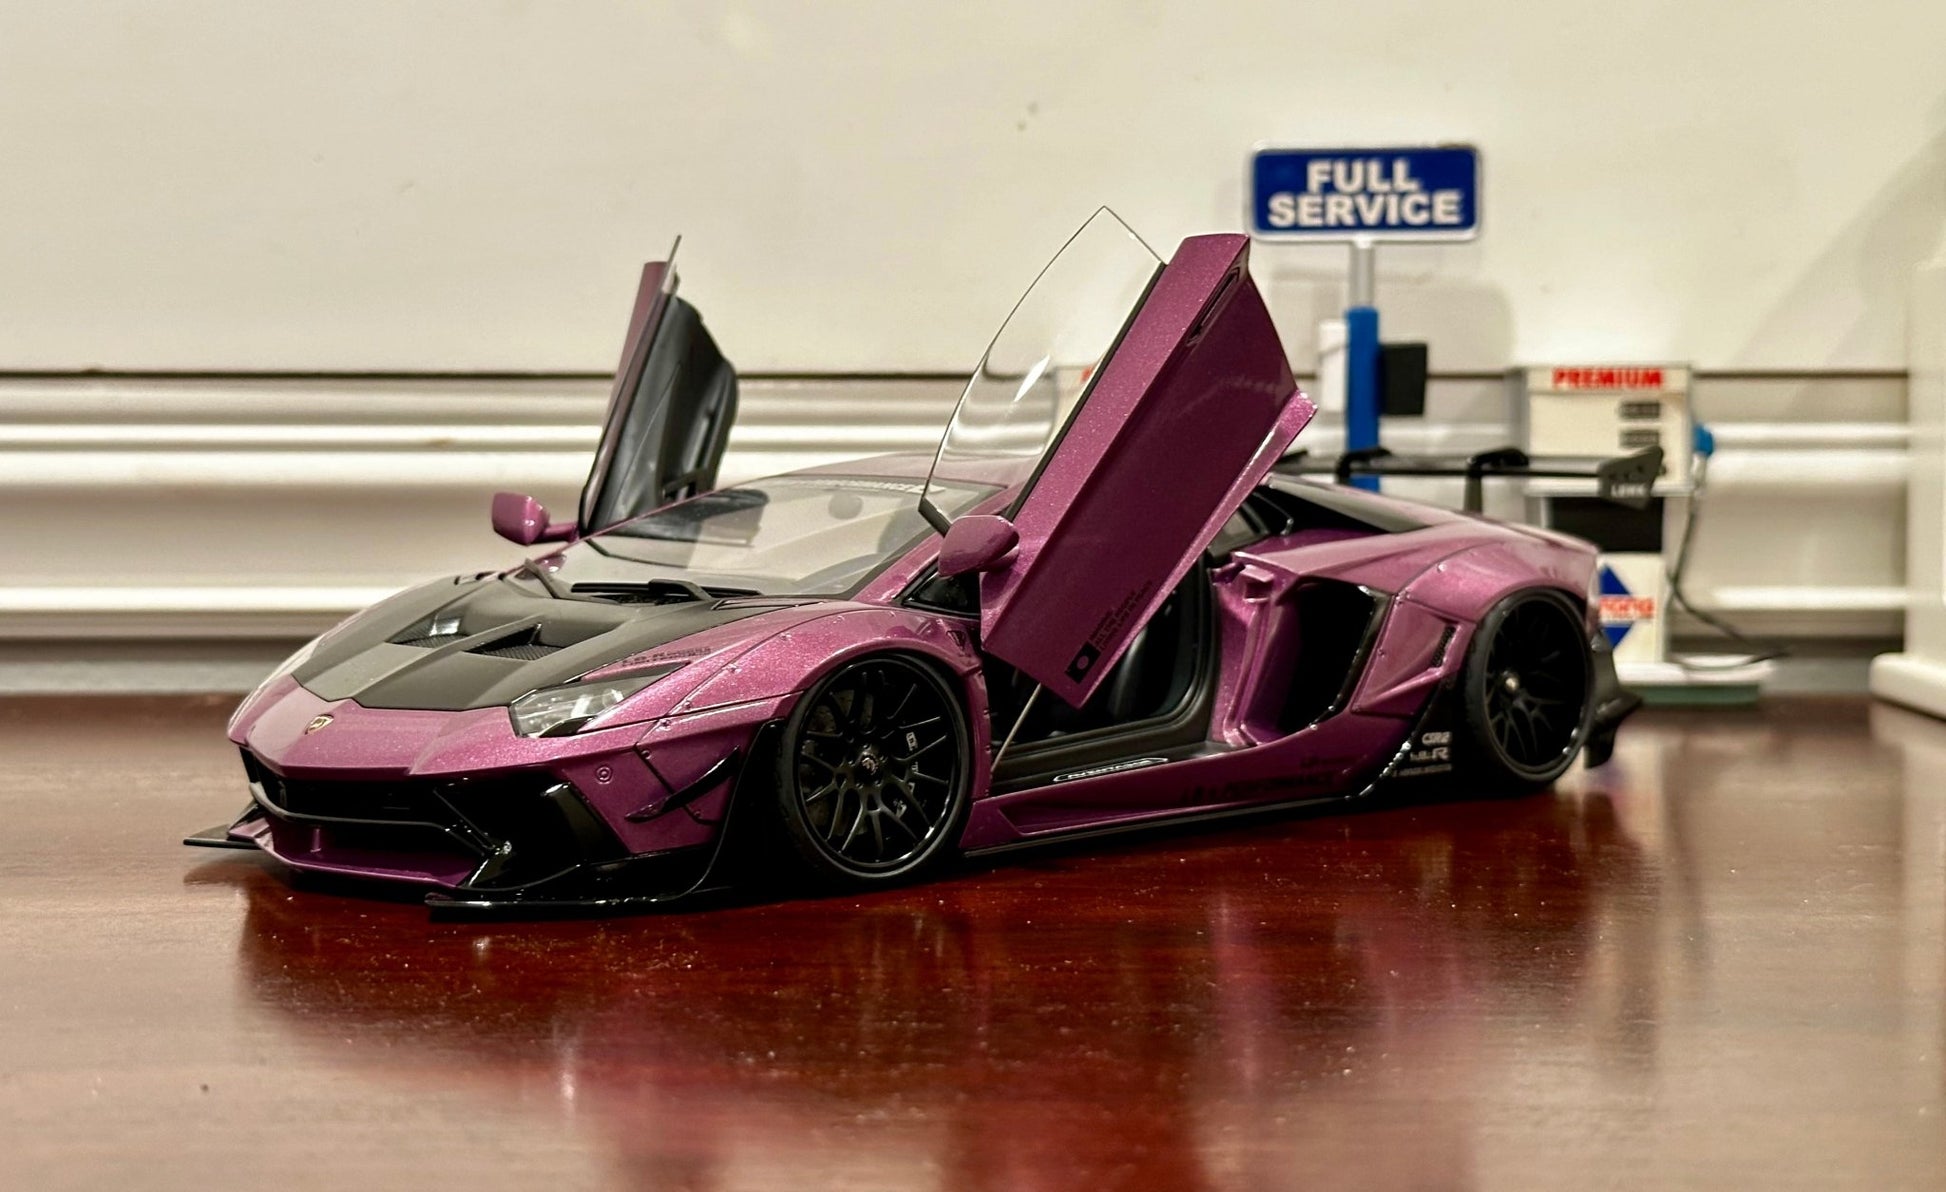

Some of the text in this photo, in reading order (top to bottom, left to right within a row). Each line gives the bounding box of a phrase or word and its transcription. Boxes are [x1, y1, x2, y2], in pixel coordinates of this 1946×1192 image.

[1307, 159, 1421, 194] FULL
[1268, 190, 1463, 228] SERVICE
[1553, 367, 1662, 390] PREMIUM
